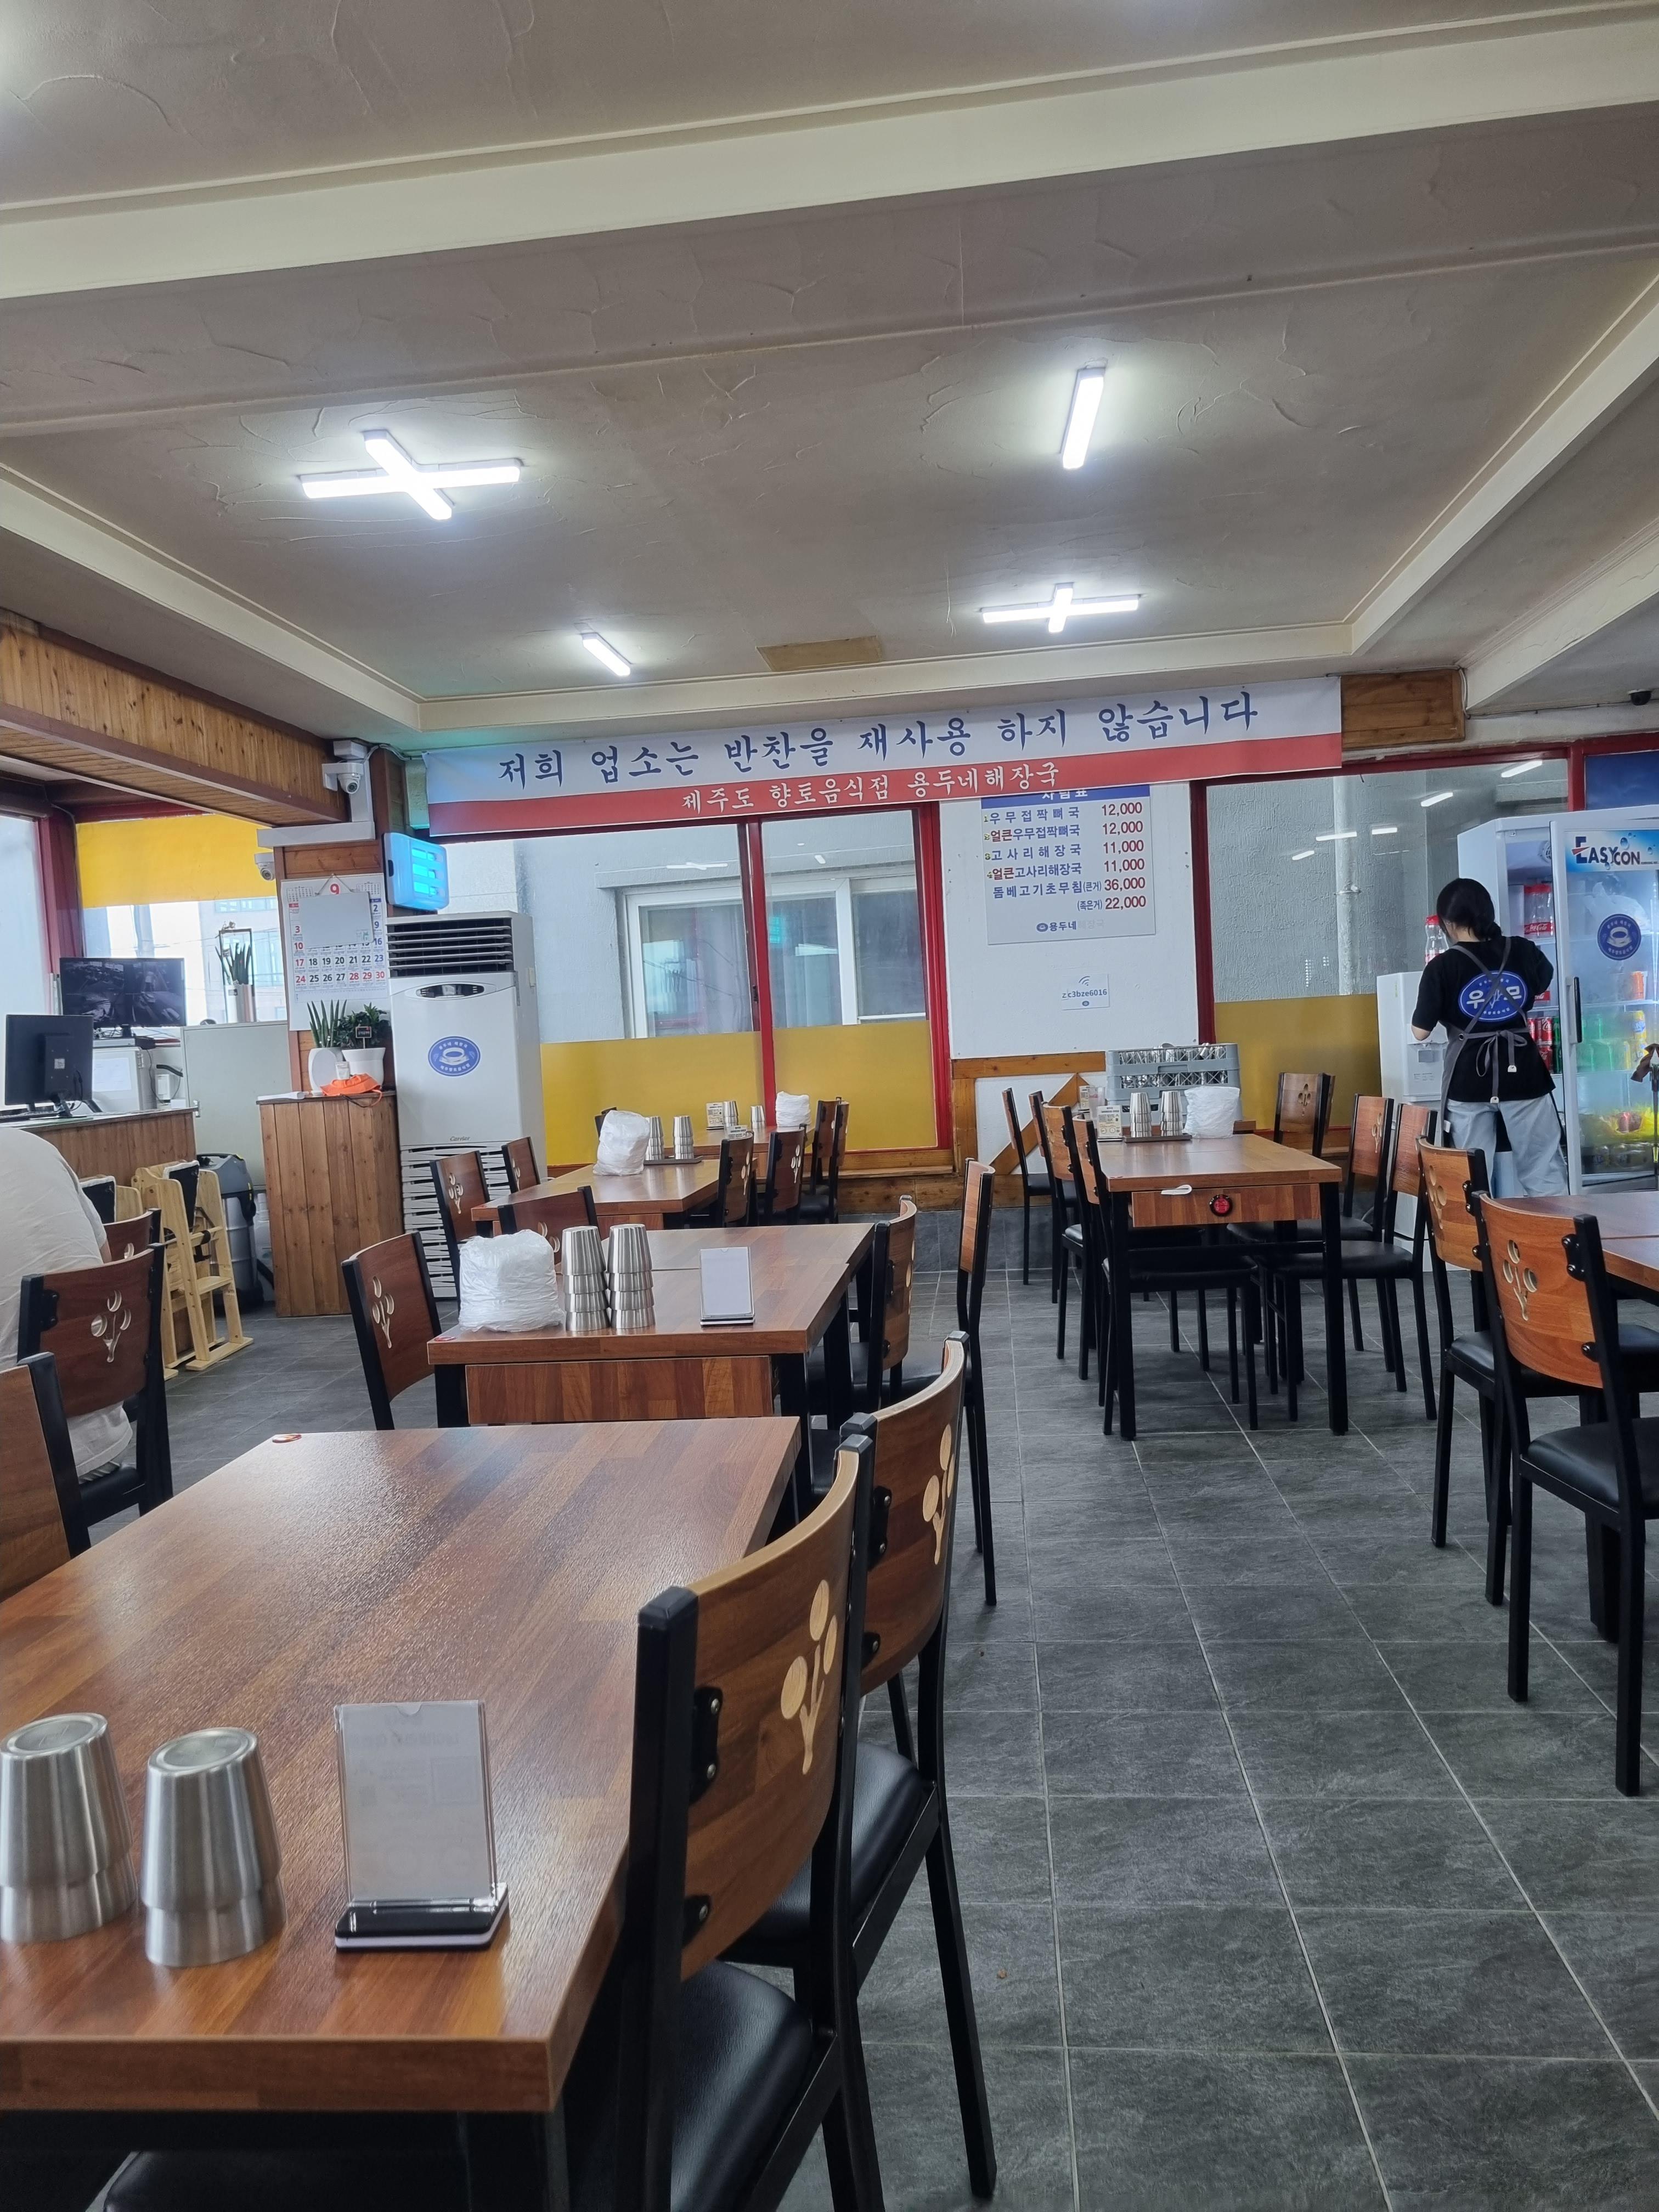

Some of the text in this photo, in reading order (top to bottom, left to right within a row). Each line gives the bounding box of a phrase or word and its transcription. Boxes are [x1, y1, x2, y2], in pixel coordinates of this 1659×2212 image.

[498, 691, 1258, 789] 저희 업소는 반찬을 재사용 하지 않습니다
[681, 787, 754, 814] 제주도
[769, 774, 888, 808] 향토음식점
[1102, 802, 1142, 816] 12,000
[1103, 821, 1143, 836] 12,000
[1103, 840, 1144, 854] 11,000
[1104, 858, 1144, 873] 11,000
[330, 883, 340, 895] 9
[1104, 877, 1145, 891] 36,000
[1105, 895, 1146, 910] 22,000
